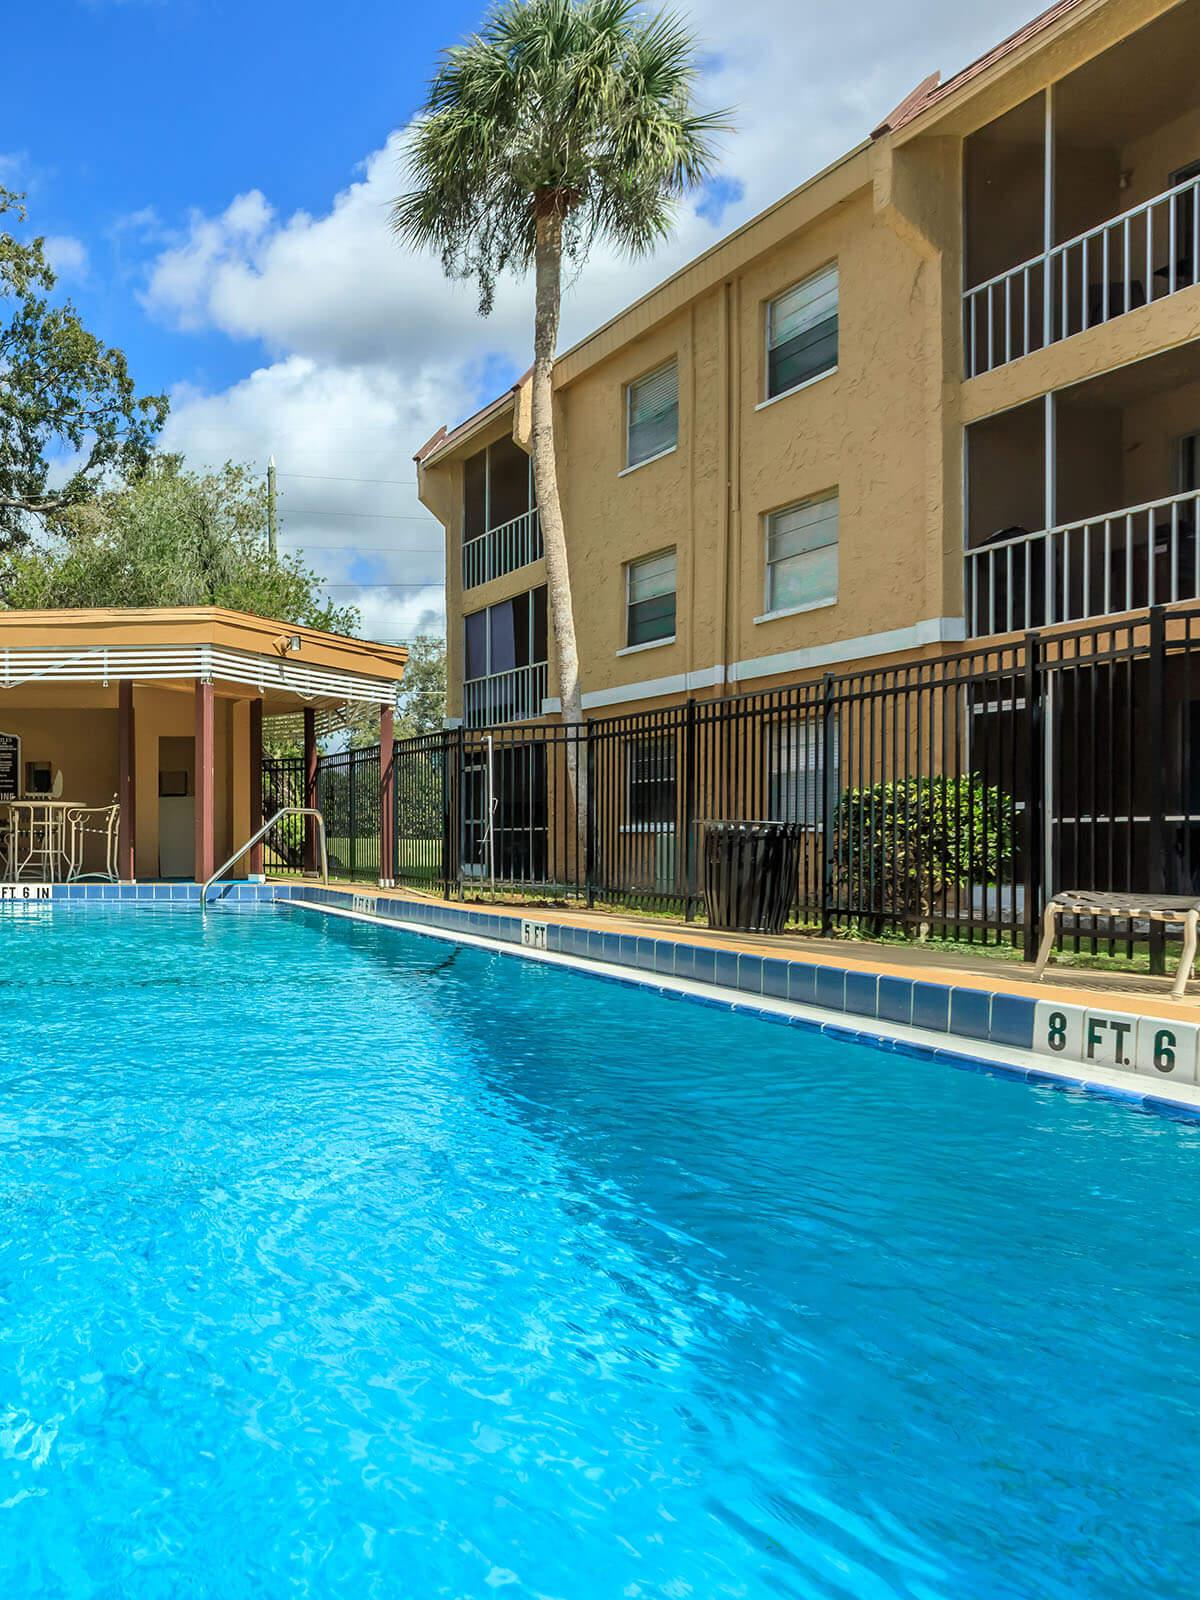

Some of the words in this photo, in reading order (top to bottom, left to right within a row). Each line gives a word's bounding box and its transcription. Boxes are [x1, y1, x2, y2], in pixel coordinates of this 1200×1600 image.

[23, 886, 30, 899] 6
[36, 887, 50, 899] IN
[525, 924, 530, 944] 5
[1047, 1011, 1067, 1052] 8
[1087, 1017, 1131, 1066] FT.
[1153, 1029, 1177, 1073] 6
